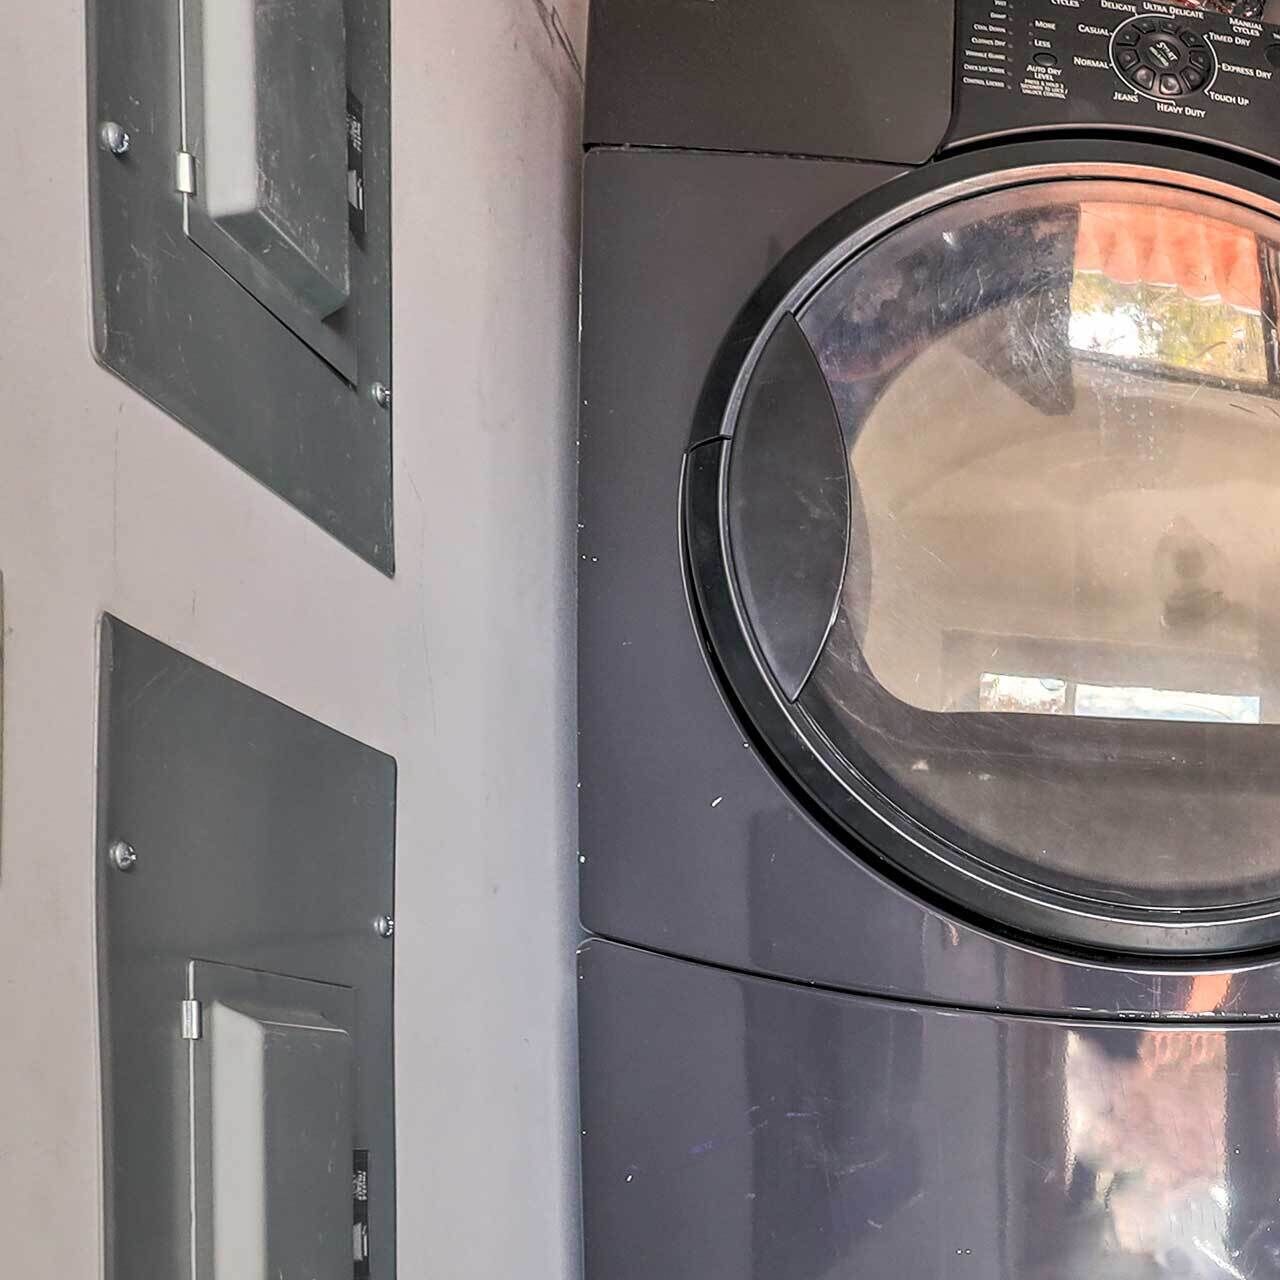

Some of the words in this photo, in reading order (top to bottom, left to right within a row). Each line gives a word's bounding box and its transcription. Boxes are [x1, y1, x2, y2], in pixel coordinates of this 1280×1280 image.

[1078, 24, 1109, 37] CASUAL
[1228, 17, 1263, 31] MANUAL
[1208, 32, 1233, 45] TIMED
[1234, 36, 1251, 47] DRY
[1073, 56, 1109, 70] NORMAL
[1221, 63, 1254, 78] EXPRESS
[1255, 69, 1272, 80] DRY
[1113, 91, 1139, 103] JEANS
[1210, 91, 1235, 104] TOUCH
[1156, 102, 1183, 115] HEAVY
[1184, 108, 1206, 118] DUTY
